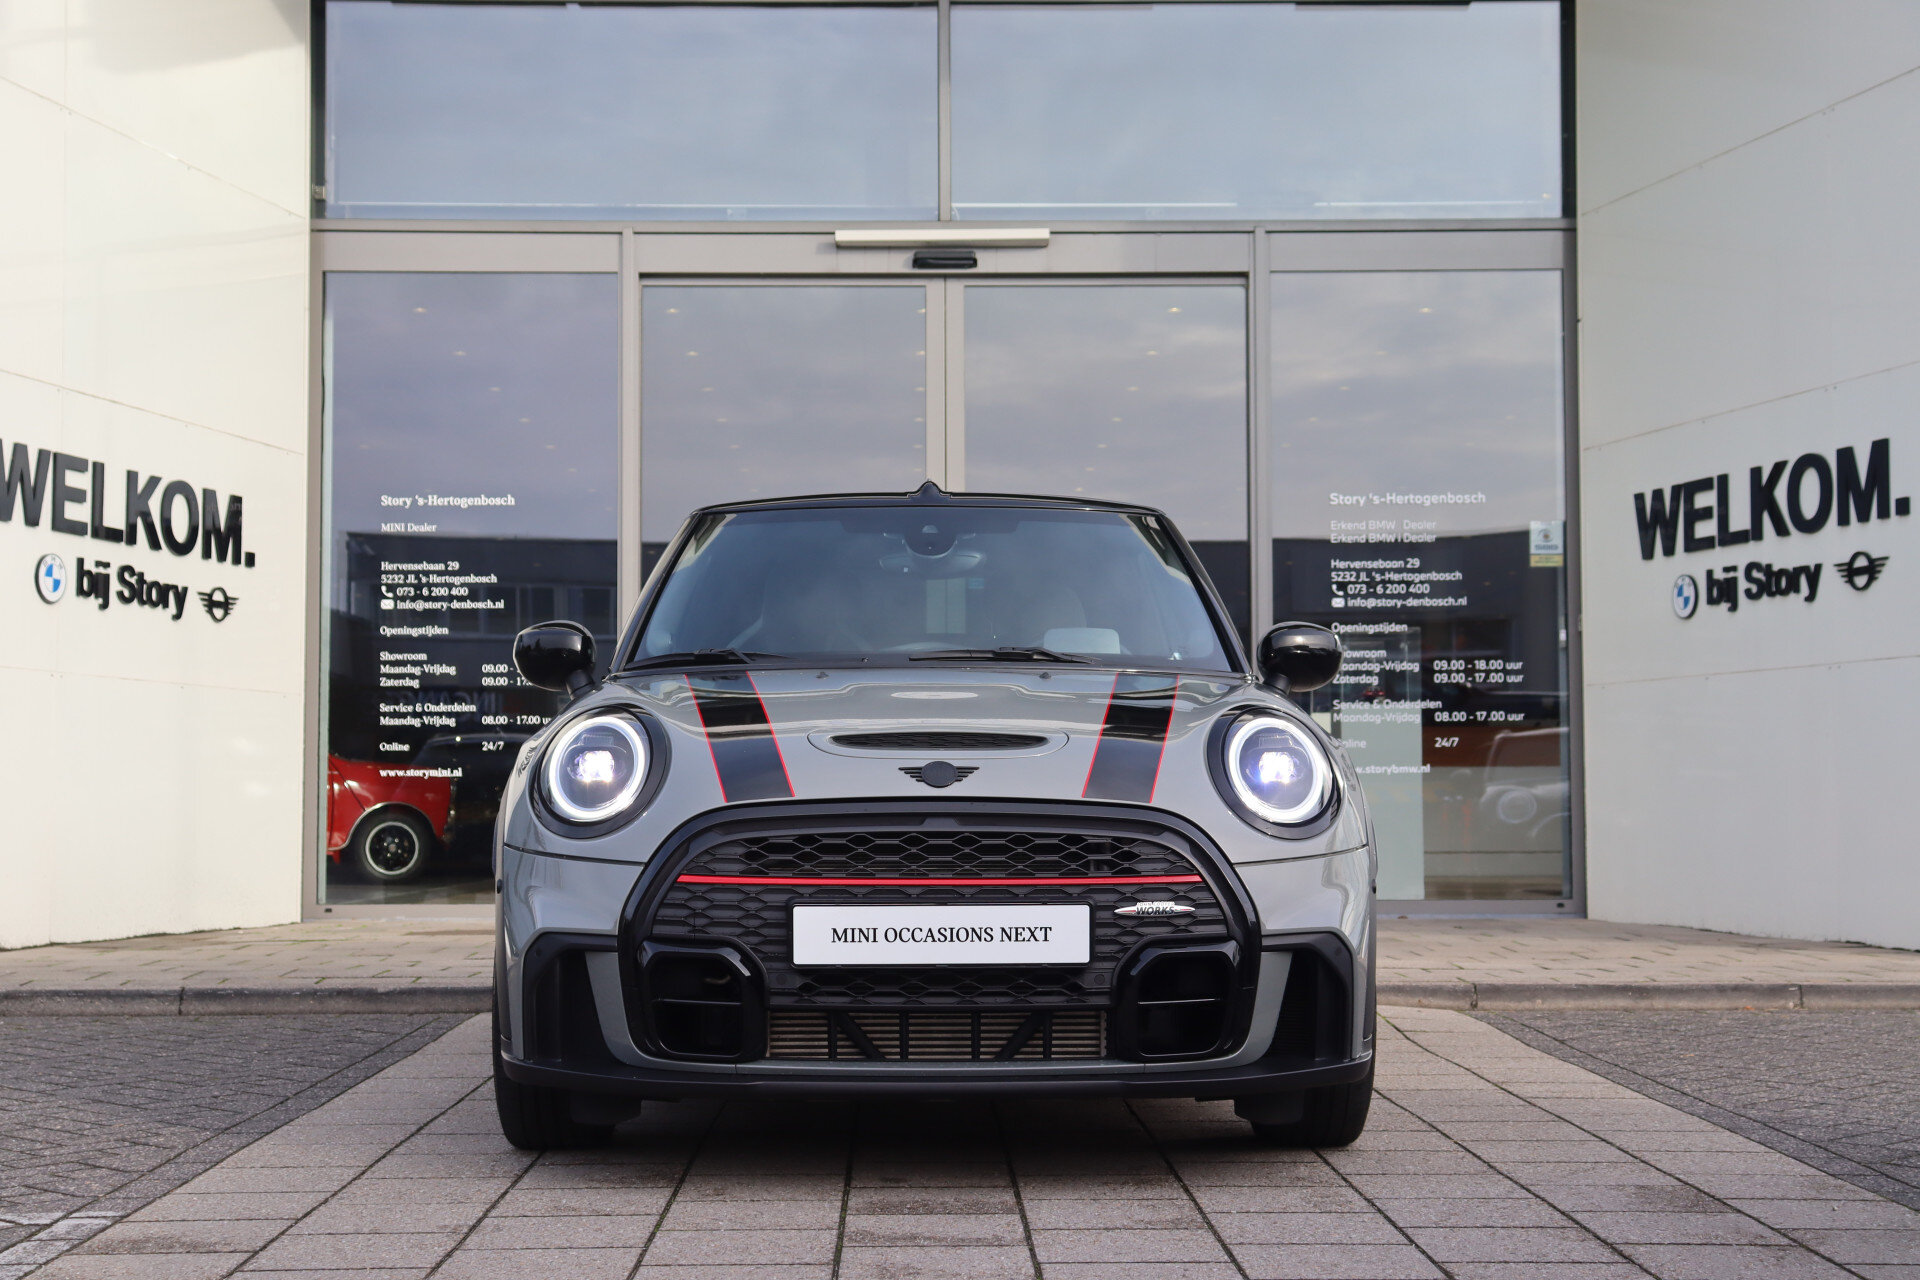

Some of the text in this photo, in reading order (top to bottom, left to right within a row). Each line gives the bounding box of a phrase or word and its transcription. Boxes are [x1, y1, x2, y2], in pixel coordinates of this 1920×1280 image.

[0, 438, 255, 568] WELKOM.
[380, 494, 412, 509] Story
[1329, 493, 1366, 507] Story
[1633, 437, 1911, 561] WELKOM.
[381, 523, 437, 532] MINI Dealer
[1331, 520, 1436, 530] Erkend BMW Dealer
[1331, 533, 1366, 543] Erkend
[1368, 533, 1396, 543] BMW
[1403, 533, 1436, 543] Dealer
[380, 561, 460, 571] Hervensebaan 29
[1331, 558, 1420, 569] Hervensebaan 29
[380, 574, 405, 584] 5232
[405, 574, 418, 584] JL
[1331, 571, 1357, 582] 5232
[1358, 571, 1371, 582] JL
[76, 557, 189, 621] bij Story
[396, 587, 415, 597] 073
[422, 587, 429, 596] 6
[431, 587, 449, 596] 200
[450, 587, 469, 596] 400
[1347, 584, 1367, 594] 073
[1376, 584, 1384, 594] 6
[1385, 584, 1407, 594] 200
[1408, 583, 1430, 594] 400
[1706, 561, 1823, 612] bij Story
[397, 599, 505, 612] info@story-denbosch.nl
[1347, 596, 1468, 609] info@story-denbosch.nl
[380, 625, 449, 637] Openingstijden
[1331, 622, 1408, 634] Openingstijden
[379, 652, 427, 661] Showroom
[1343, 650, 1387, 658] owroom
[379, 664, 456, 676] Maandag-Vrijdag
[481, 664, 509, 674] 09.00
[1341, 660, 1420, 673] aandag-Vrijdag
[1433, 659, 1465, 671] 09.00
[1474, 659, 1504, 670] 18.00
[1505, 661, 1523, 670] uur
[379, 677, 420, 689] Zaterdag
[481, 676, 509, 686] 09.00
[1332, 673, 1379, 686] Zaterdag
[1433, 673, 1466, 684] 09.00
[1506, 674, 1524, 683] uur
[379, 702, 477, 713] Service & Onderdelen
[1332, 699, 1443, 710] Service & Onderdelen
[379, 715, 456, 727] Maandag-Vrijdag
[481, 715, 509, 725] 08.00
[516, 715, 541, 725] 17.00
[1333, 711, 1421, 724] Maandag-Vrijdag
[1434, 711, 1467, 722] 08.00
[1507, 713, 1525, 722] uur
[379, 741, 504, 751] Online 24/7
[1343, 737, 1460, 748] nline 24/7
[379, 767, 463, 779] www.storymini.nl
[1356, 764, 1431, 776] w.storybmw.nl
[1136, 906, 1175, 915] WORKS
[831, 926, 1053, 943] MINI OCCASIONS NEXT
